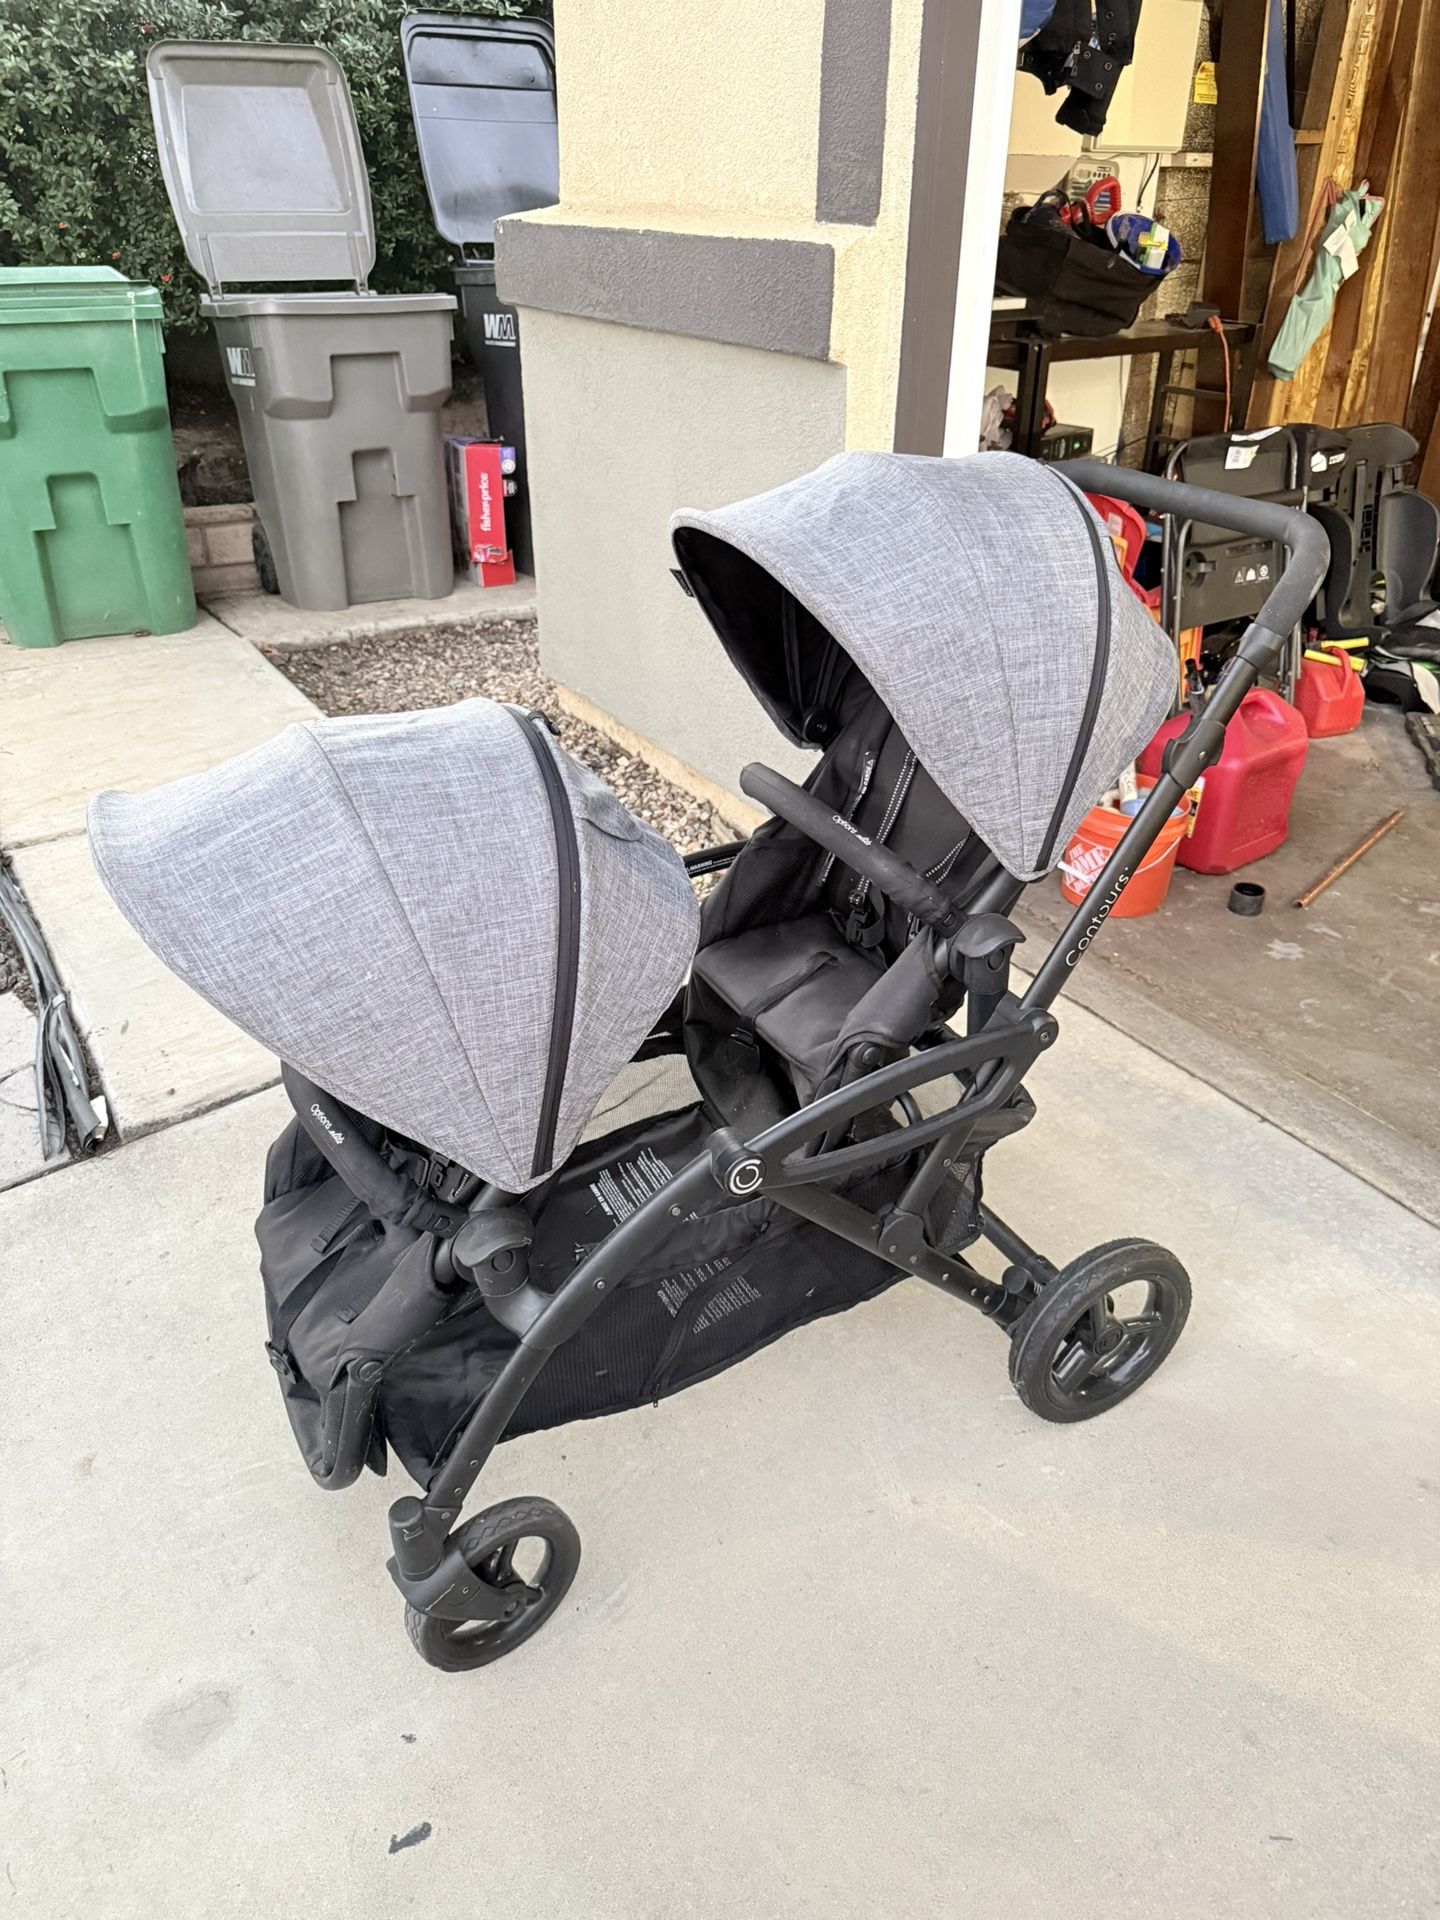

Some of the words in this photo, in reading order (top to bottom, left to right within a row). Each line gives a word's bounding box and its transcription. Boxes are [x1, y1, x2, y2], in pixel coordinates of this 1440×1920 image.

[483, 313, 516, 340] WM
[832, 815, 858, 834] Options
[1065, 873, 1129, 967] Contours
[310, 1103, 332, 1130] Options
